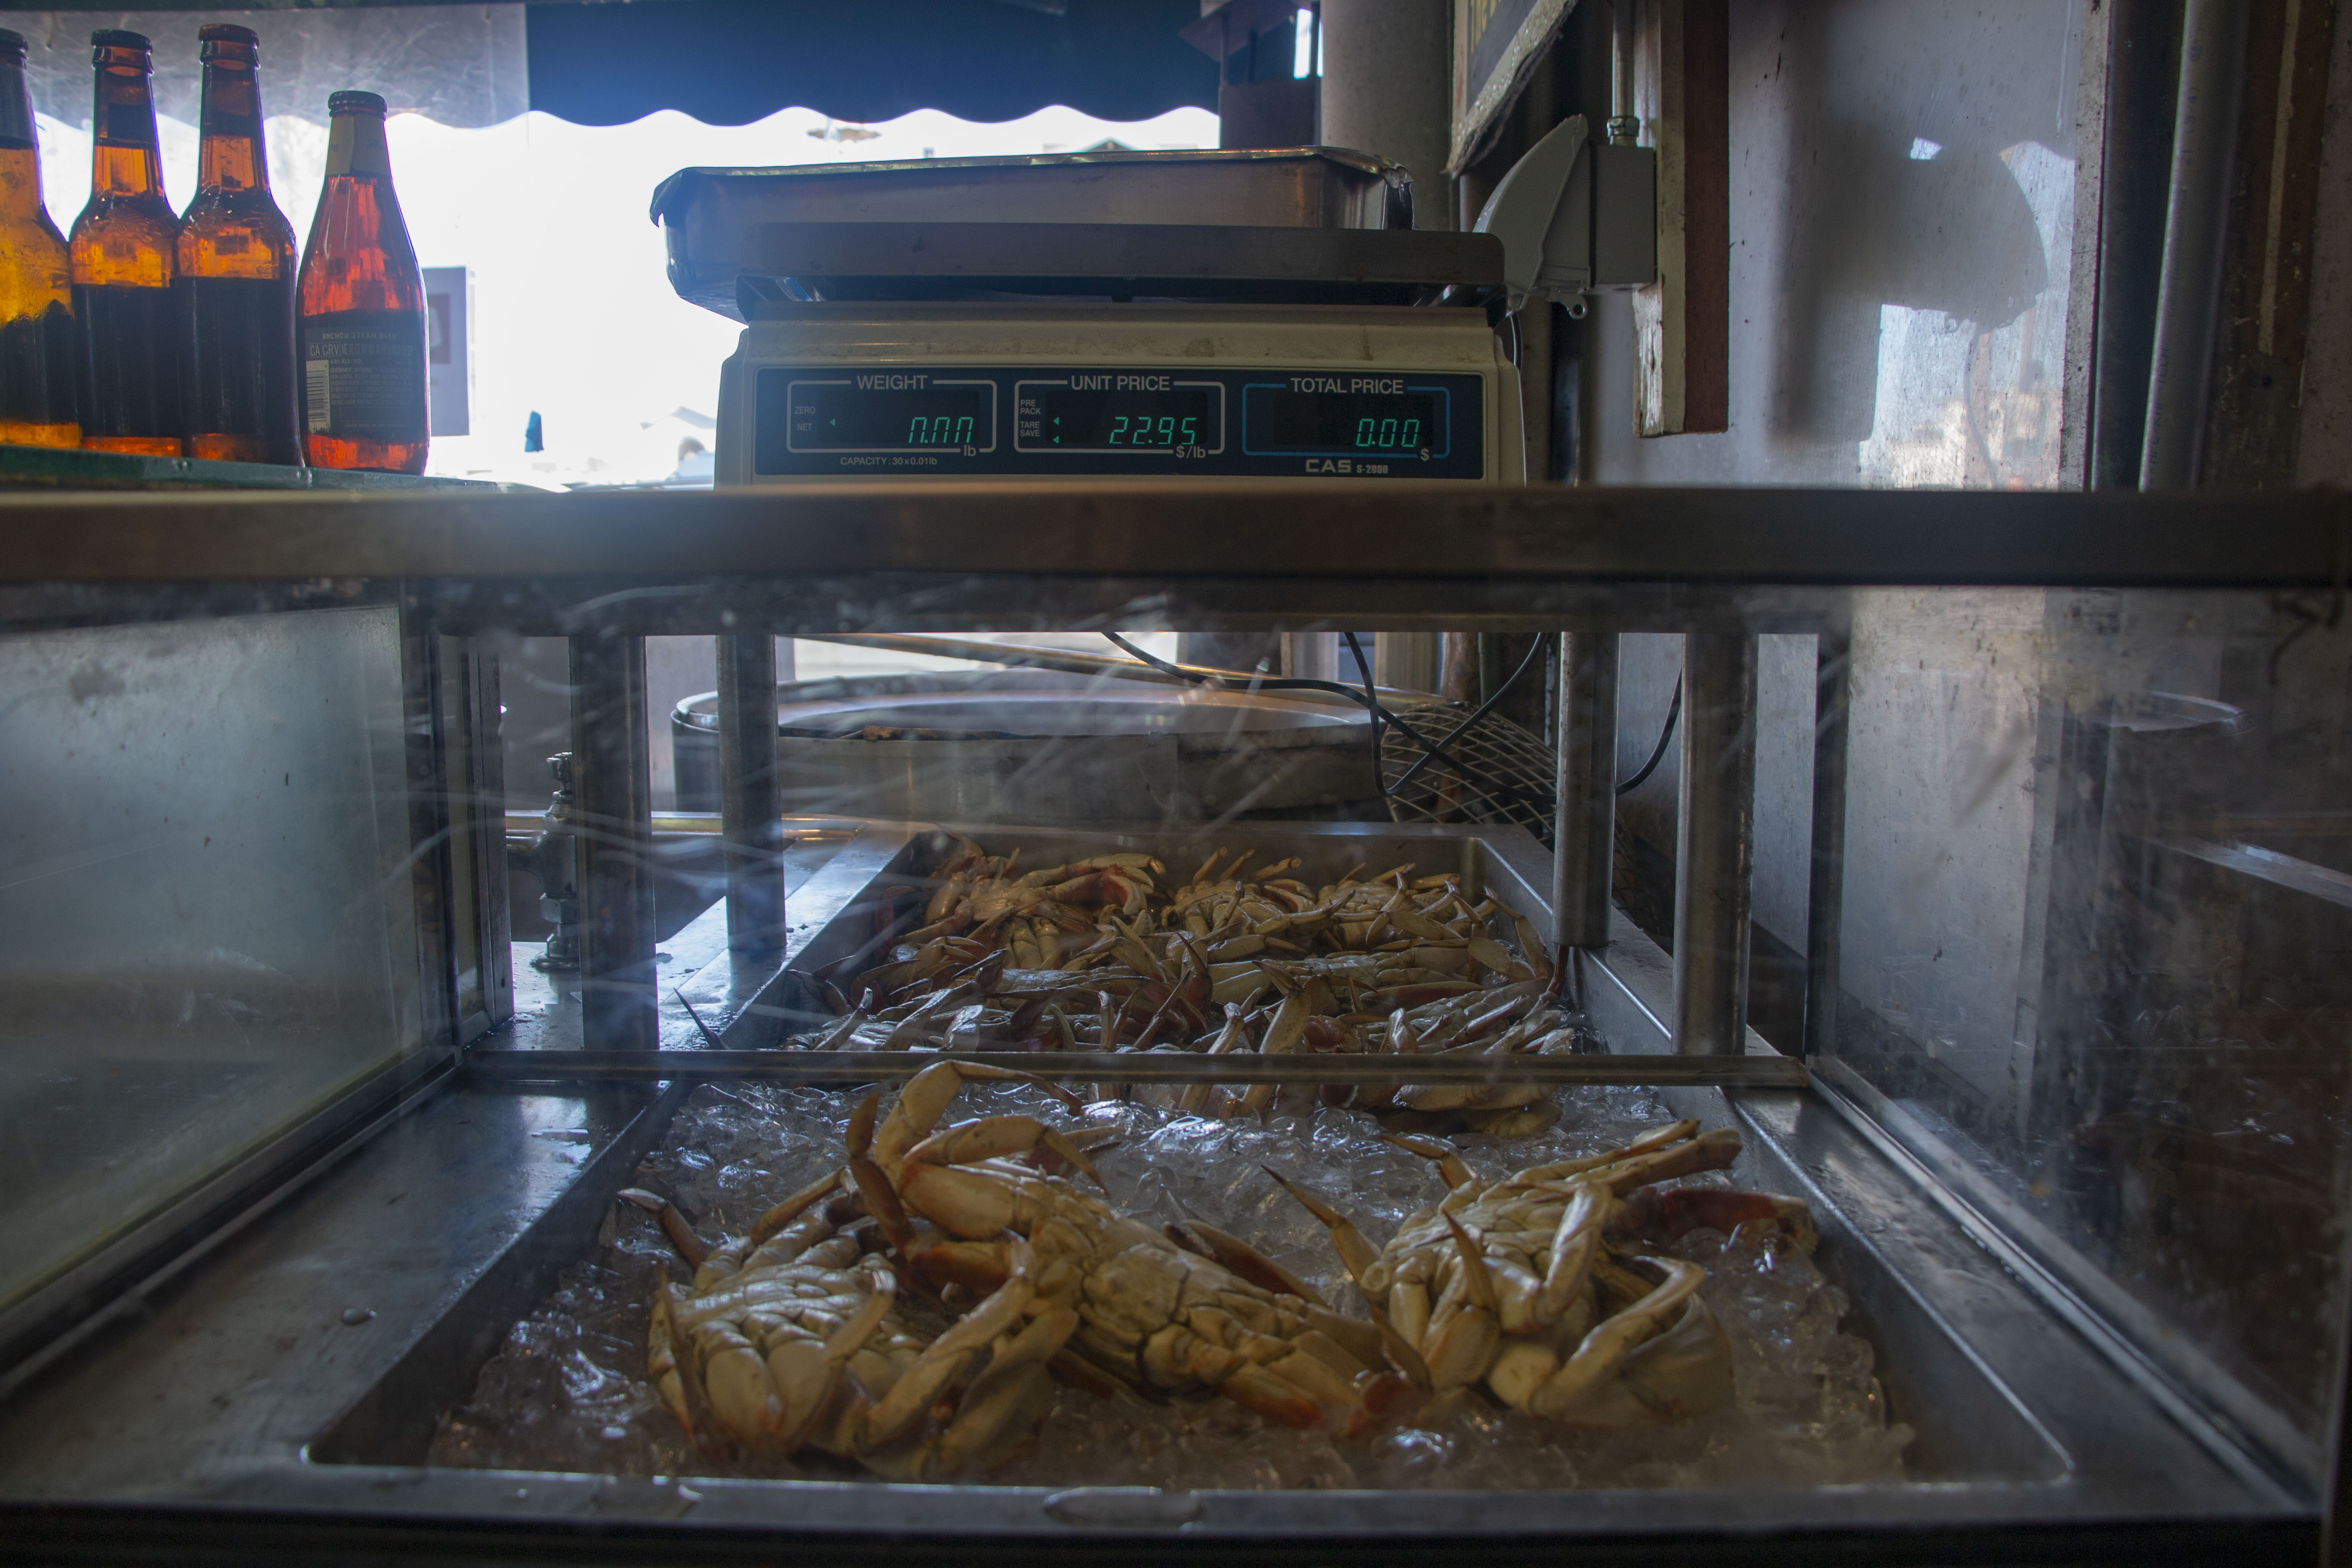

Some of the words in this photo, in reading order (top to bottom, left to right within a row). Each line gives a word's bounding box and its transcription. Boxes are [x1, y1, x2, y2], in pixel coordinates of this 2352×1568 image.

[310, 344, 321, 357] CA
[322, 343, 340, 356] CRV
[857, 375, 927, 390] WEIGHT
[1071, 375, 1112, 390] UNIT
[1117, 376, 1170, 391] PRICE
[1290, 378, 1348, 393] TOTAL
[1351, 378, 1403, 394] PRICE
[794, 406, 815, 415] ZERO
[797, 423, 812, 431] NET
[1109, 416, 1197, 445] 22.95
[1355, 418, 1420, 447] 0.00
[964, 444, 977, 457] lb
[1176, 445, 1206, 459] $/lb
[1421, 448, 1430, 462] $
[1305, 459, 1352, 473] CAS
[1356, 464, 1389, 474] S-2000
